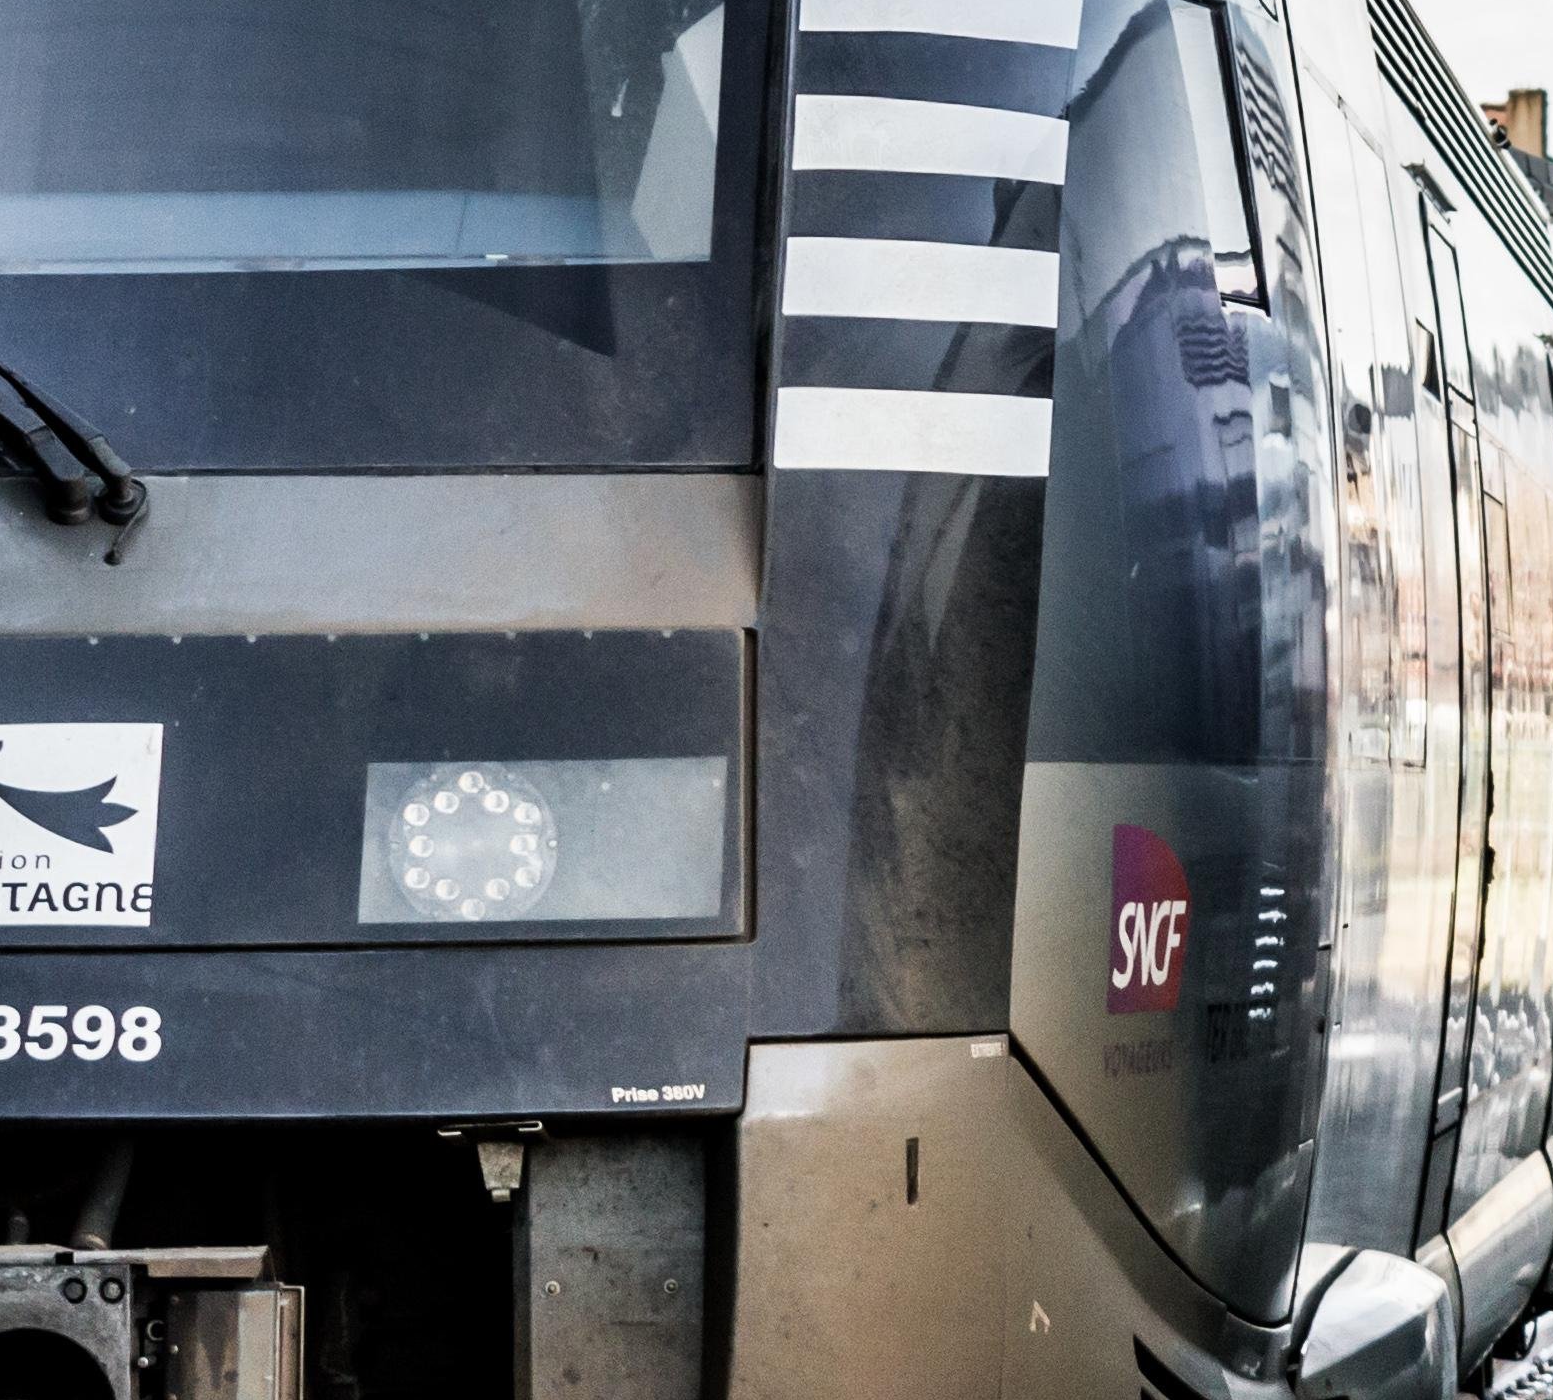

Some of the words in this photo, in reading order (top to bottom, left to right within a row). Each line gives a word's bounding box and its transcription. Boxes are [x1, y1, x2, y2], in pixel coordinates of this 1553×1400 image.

[1111, 900, 1187, 990] SNCF
[611, 1086, 659, 1103] Prise
[661, 1083, 706, 1101] 380V
